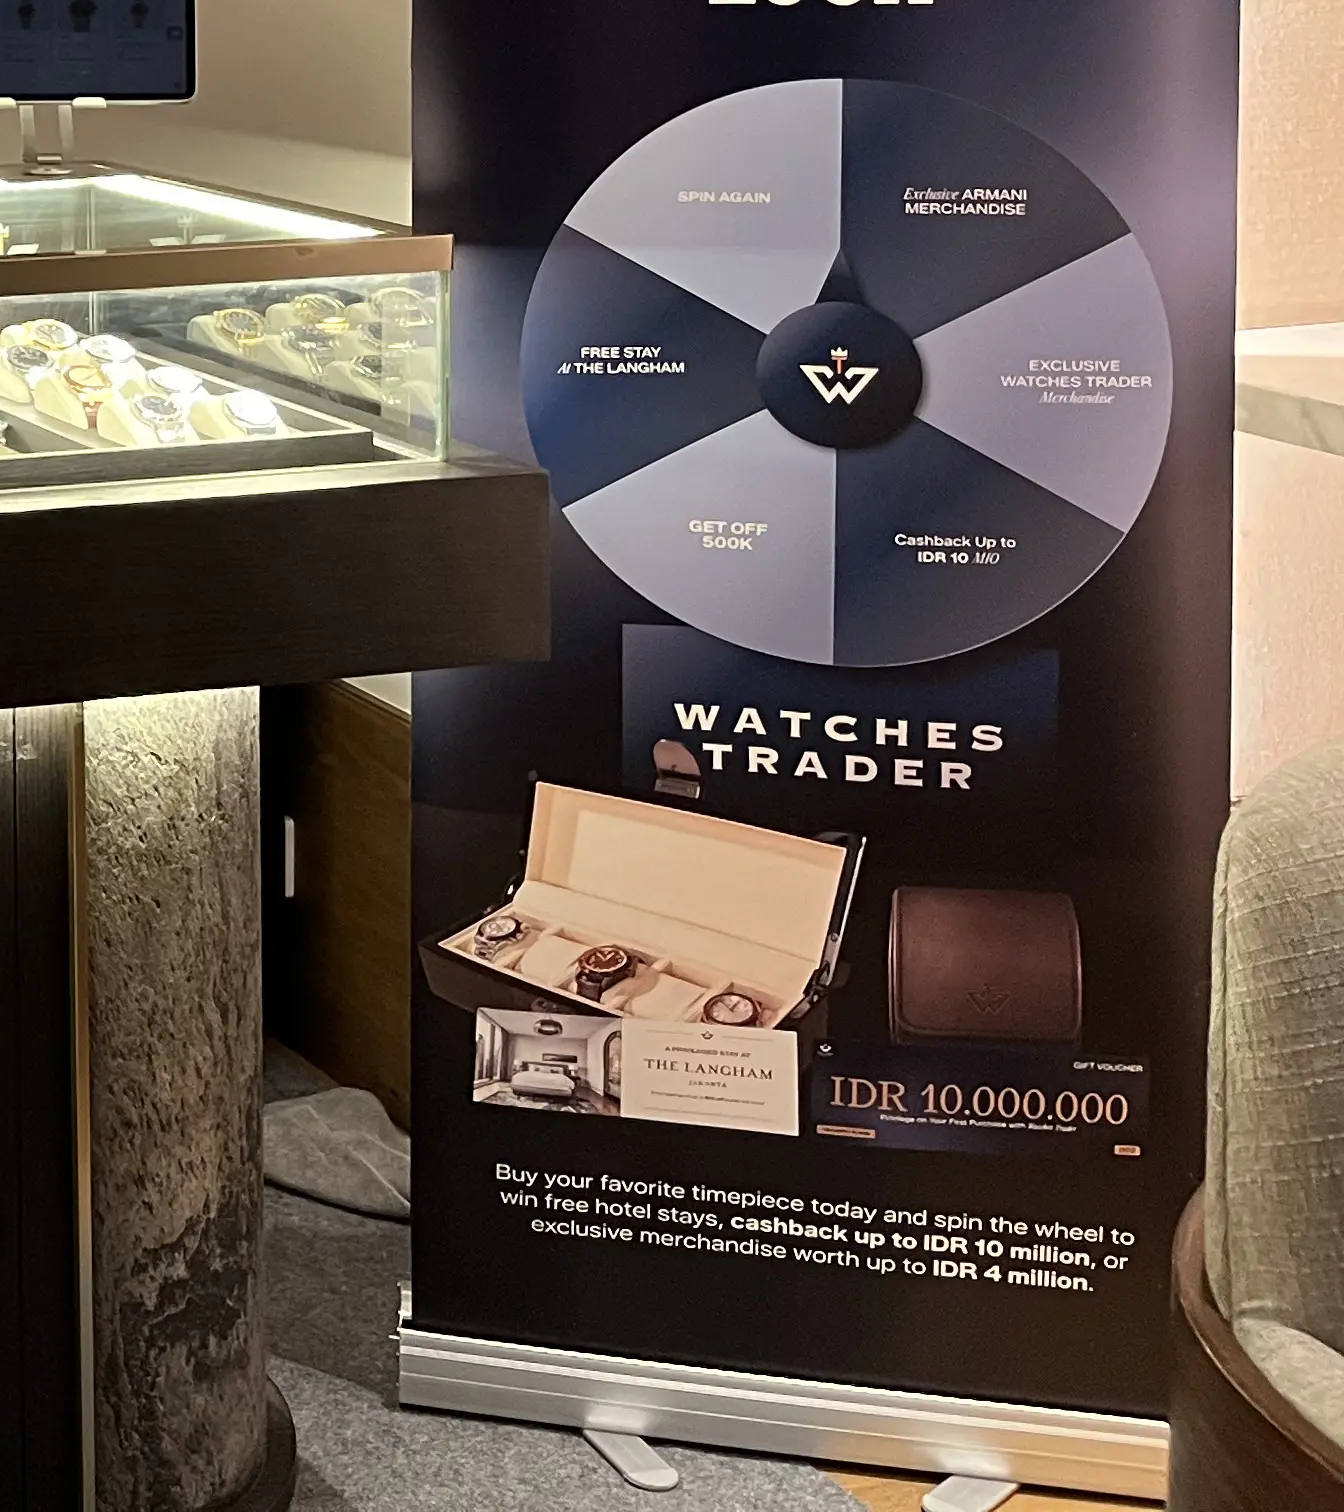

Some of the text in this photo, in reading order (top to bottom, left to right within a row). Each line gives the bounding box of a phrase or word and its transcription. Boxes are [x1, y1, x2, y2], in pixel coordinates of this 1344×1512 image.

[678, 191, 771, 203] SPIN AGAIN
[903, 187, 1027, 200] Exclusive ARMANI
[905, 202, 1026, 215] MERCHANDISE
[581, 347, 661, 358] FREE STAY
[573, 362, 604, 374] THE
[607, 362, 685, 374] LANGHAM
[1029, 359, 1121, 372] EXCLUSIVE
[1000, 375, 1152, 388] WATCHES TRADER
[1038, 391, 1116, 404] Merchandise
[688, 519, 768, 536] GET OFF
[702, 535, 753, 550] 500K
[894, 533, 1017, 549] Cashback Up to
[917, 551, 947, 563] IDR
[950, 552, 969, 564] 10
[674, 703, 1004, 752] WATCHES
[702, 743, 972, 790] TRADER
[644, 1058, 773, 1080] THE LANGHAM
[1073, 1061, 1143, 1073] GIFT VOUCHER
[830, 1075, 1128, 1125] IDR 10.000.000
[496, 1163, 1135, 1246] Buy your favorite timepiece today and spin the wheel to
[500, 1189, 1129, 1270] win free hotel stays, cashback up to IDR 10 million, or
[531, 1218, 1094, 1291] exclusive merchandise worth up to IDR 4 million.
